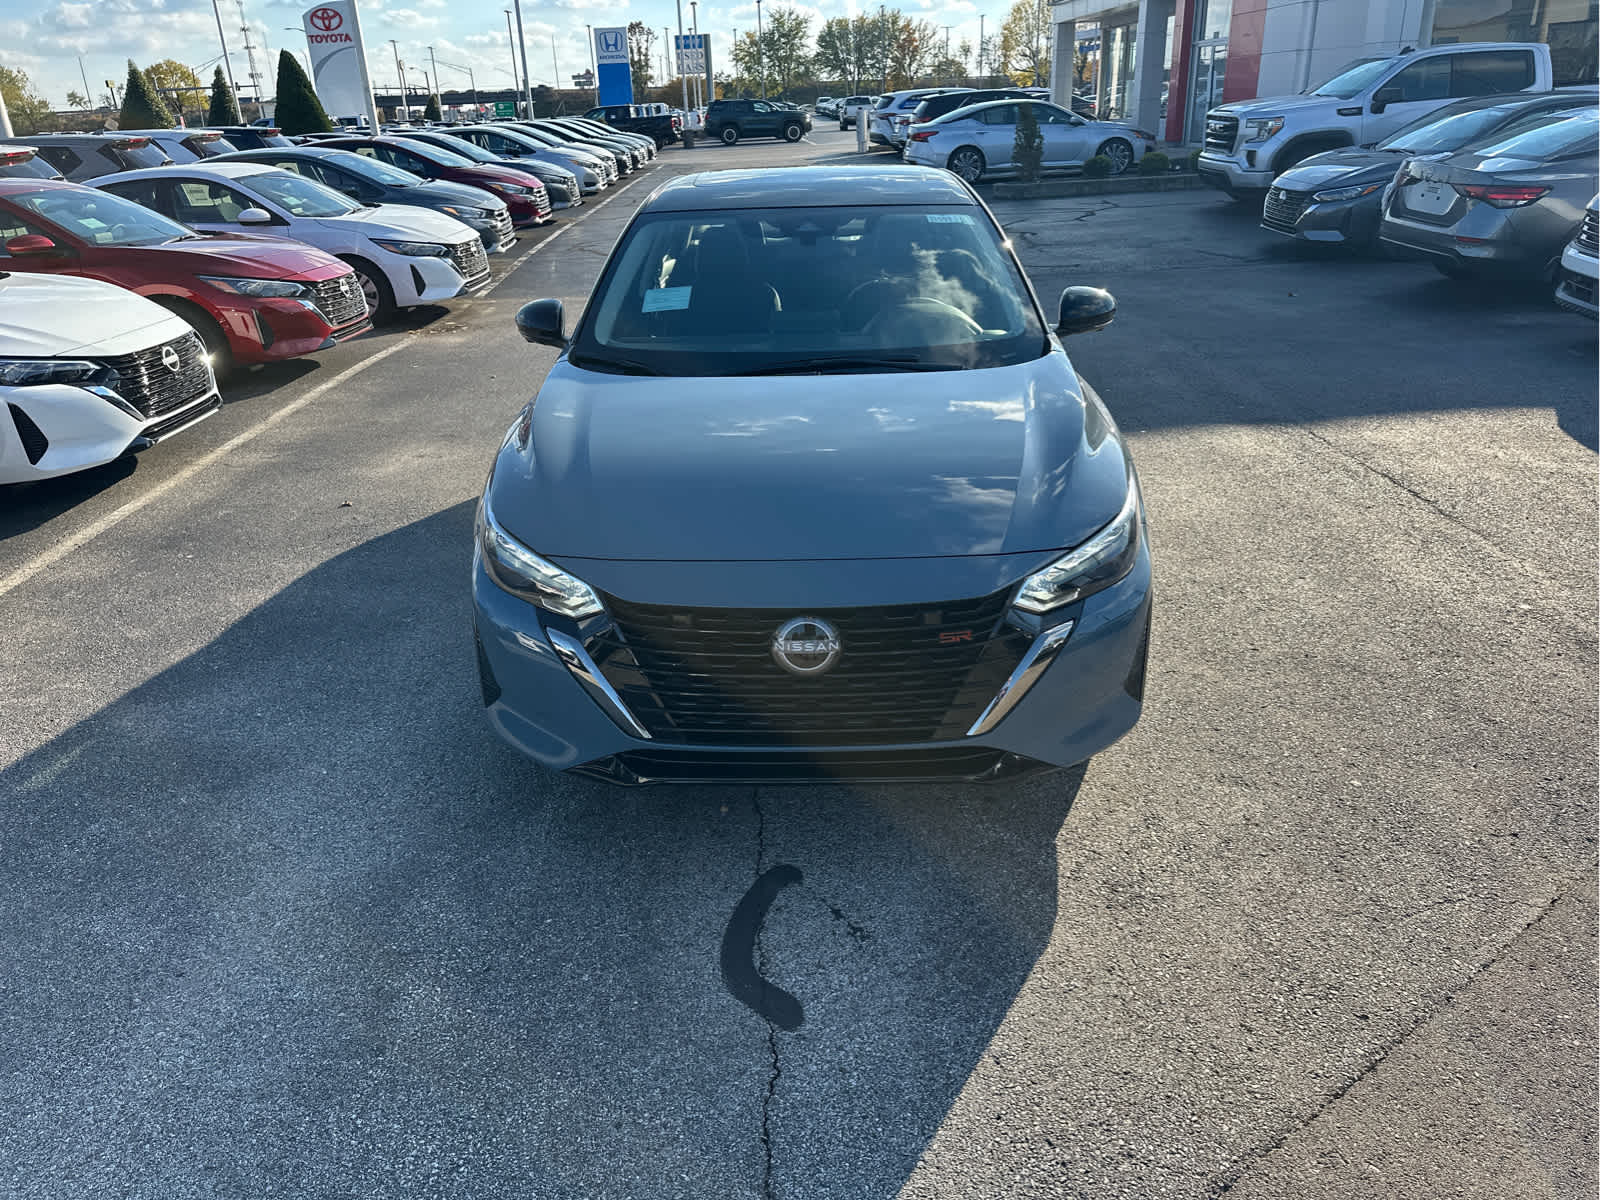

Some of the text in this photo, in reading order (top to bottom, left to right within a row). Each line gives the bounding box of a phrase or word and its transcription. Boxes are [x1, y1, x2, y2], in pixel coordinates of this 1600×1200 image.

[308, 33, 352, 44] TOYOTA
[939, 630, 972, 643] SR
[774, 639, 839, 653] NISSAN
